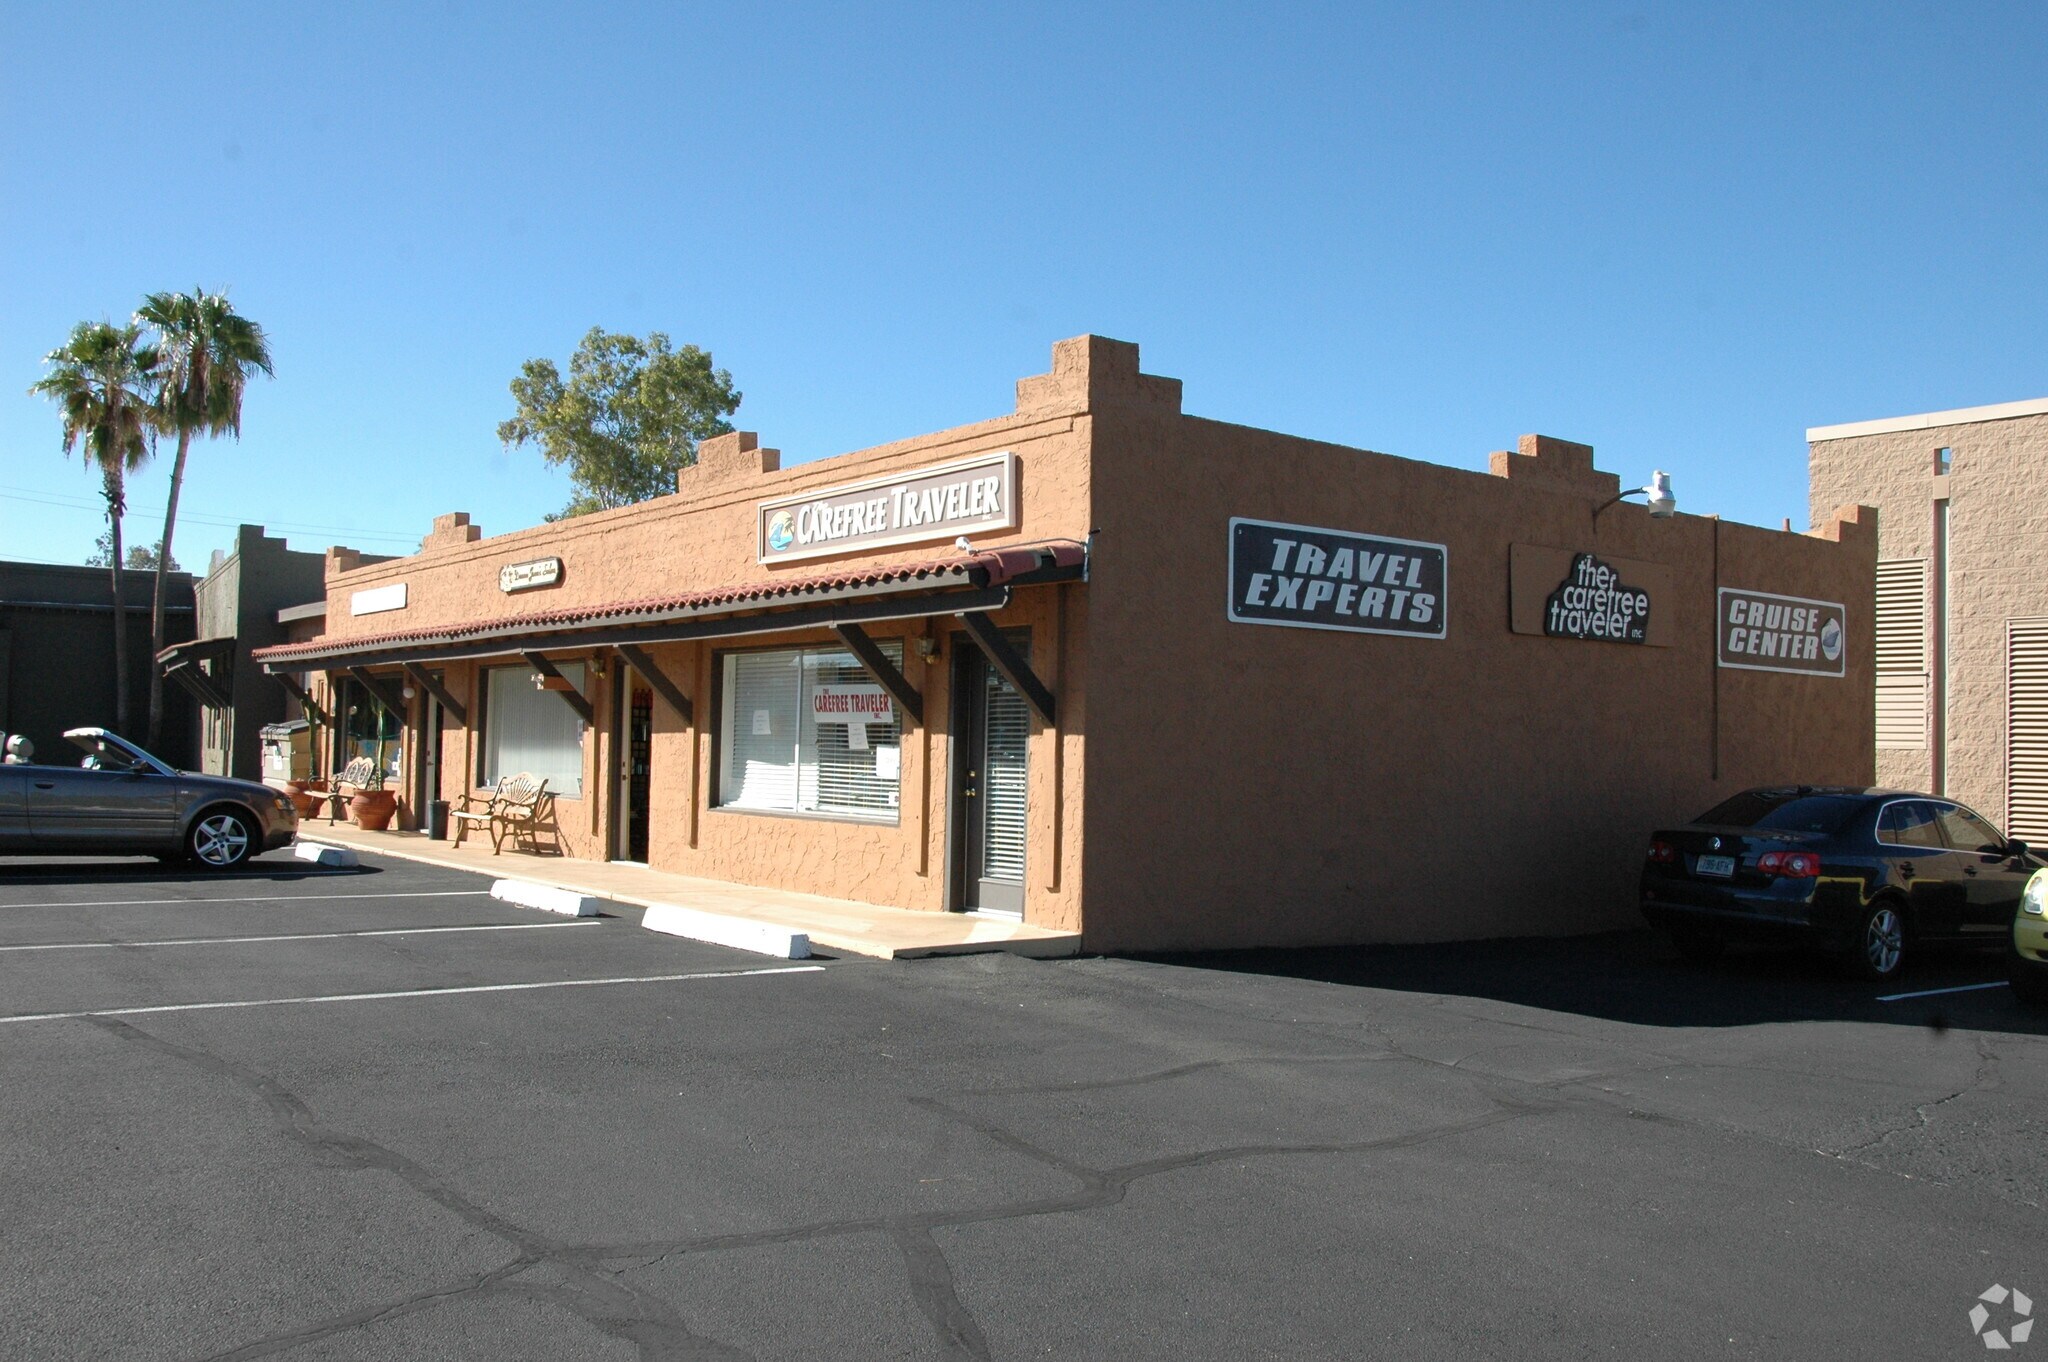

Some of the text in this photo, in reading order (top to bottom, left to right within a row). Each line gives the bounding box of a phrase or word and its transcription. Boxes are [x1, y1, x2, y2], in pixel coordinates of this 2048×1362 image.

[797, 475, 1001, 545] CAREFREE TRAVELER
[1271, 538, 1422, 589] TRAVEL
[1578, 555, 1610, 589] the
[1245, 572, 1436, 623] EXPERTS
[1563, 574, 1648, 617] carefree
[1550, 600, 1632, 638] traveler
[1728, 599, 1819, 633] CRUISE
[1728, 627, 1819, 660] CENTER
[814, 694, 890, 713] CAREFREE TRAVELER
